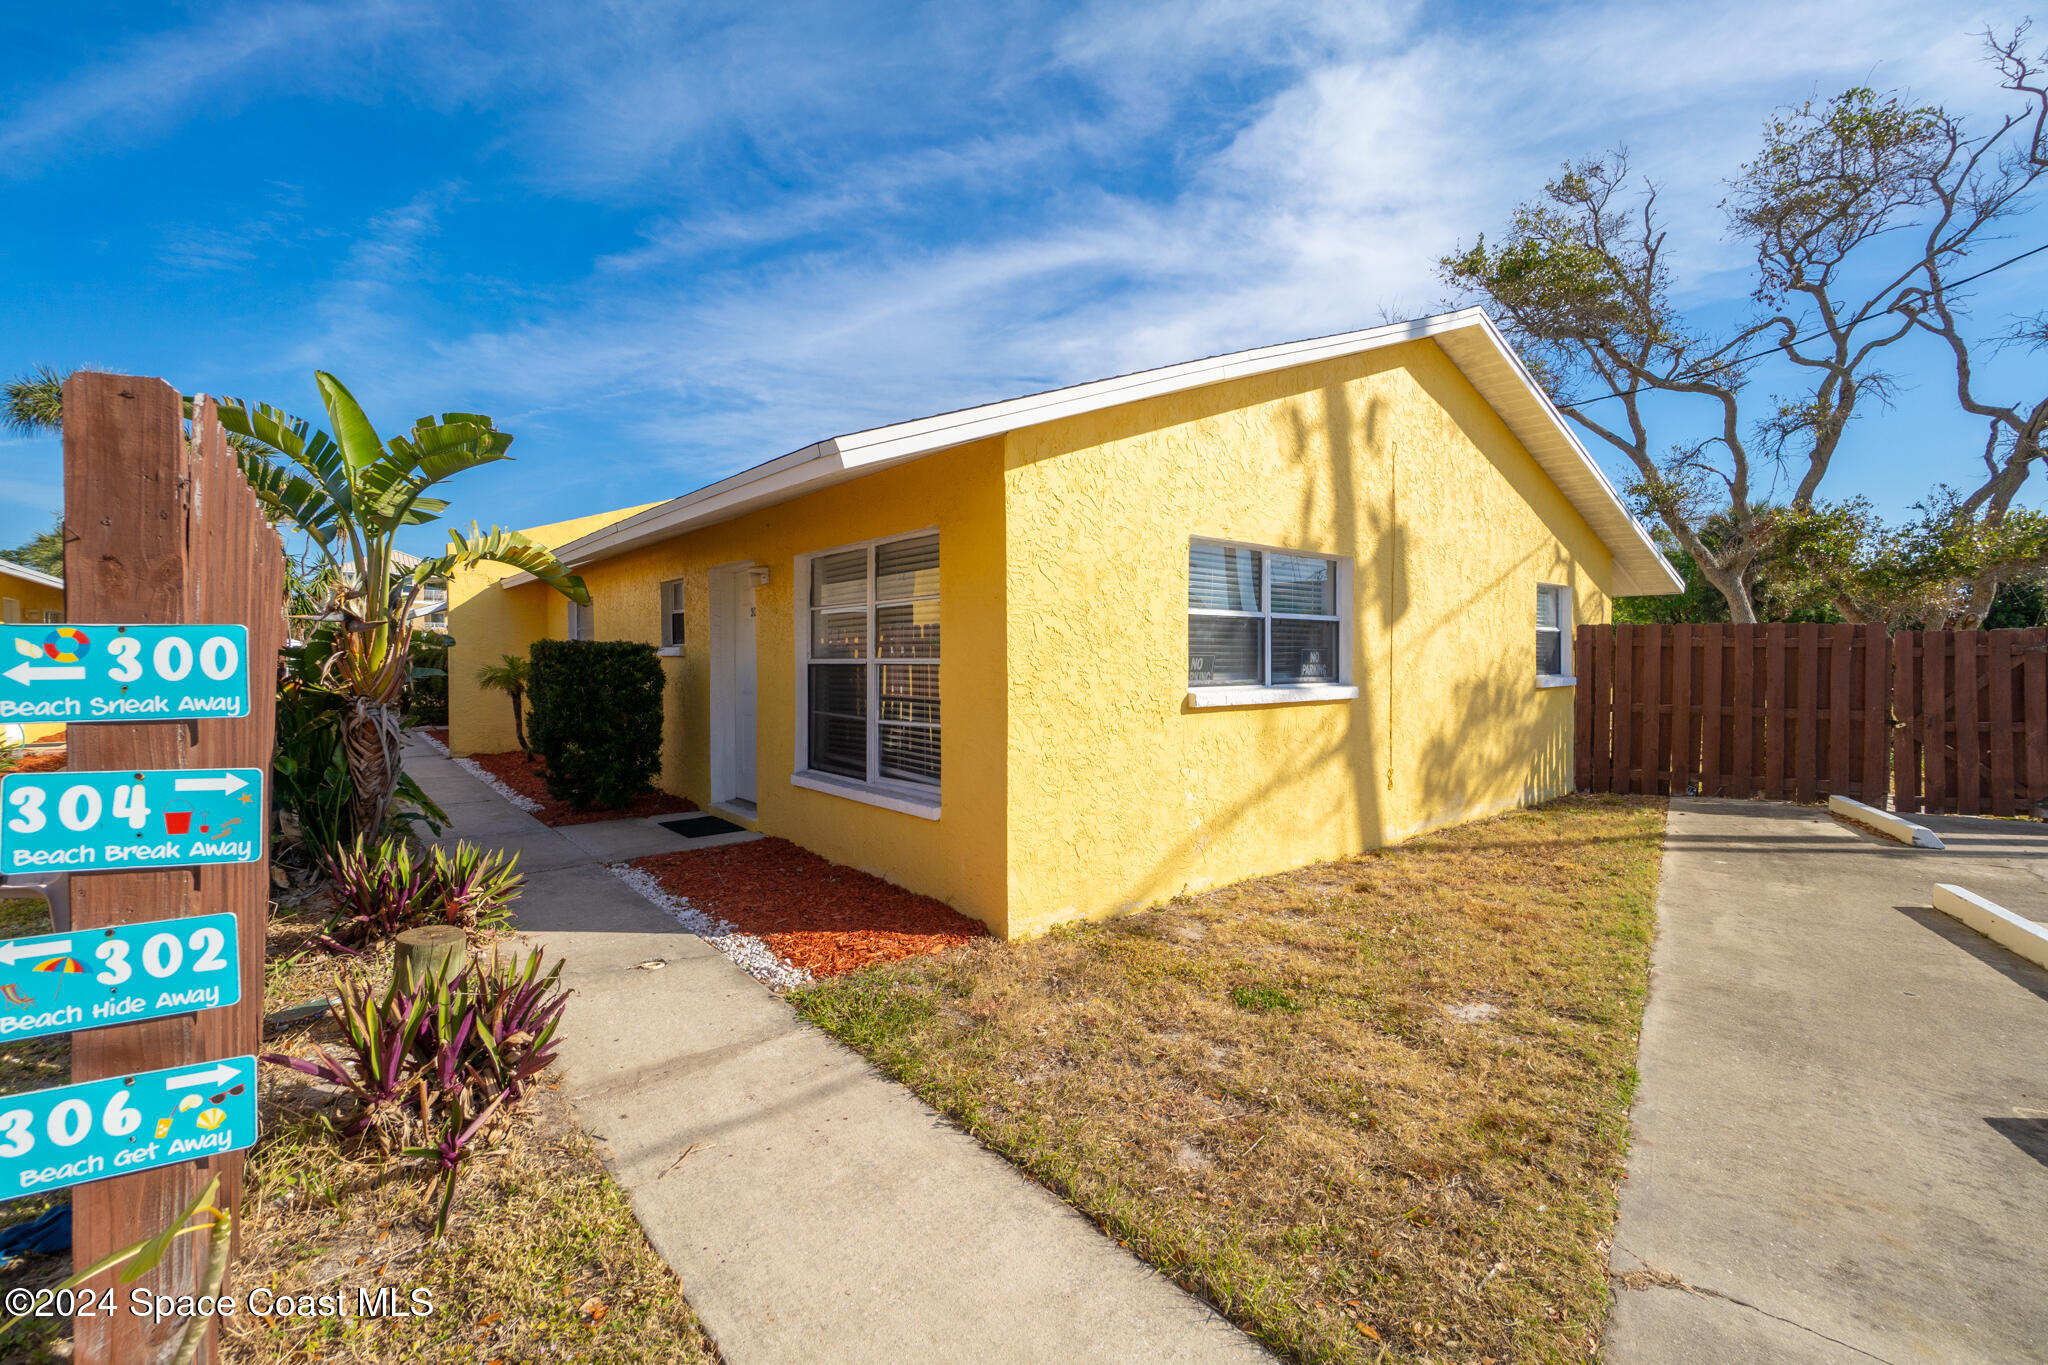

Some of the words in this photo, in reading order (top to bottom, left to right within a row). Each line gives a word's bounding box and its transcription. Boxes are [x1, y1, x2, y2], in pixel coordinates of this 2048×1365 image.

[107, 636, 239, 682] 300
[1191, 657, 1203, 670] NO
[1310, 651, 1320, 663] NO
[0, 697, 81, 717] Beach
[90, 696, 170, 716] Sneak
[178, 696, 241, 717] Away
[8, 784, 151, 834] 304
[13, 845, 96, 867] Beach
[105, 841, 181, 862] Break
[189, 841, 252, 861] Away
[95, 927, 228, 986] 302
[0, 1005, 83, 1034] Beach
[92, 996, 147, 1019] Hide
[155, 986, 220, 1008] Away
[0, 1090, 142, 1158] 306
[19, 1155, 104, 1188] Beach
[113, 1141, 160, 1168] Get
[168, 1129, 233, 1155] Away
